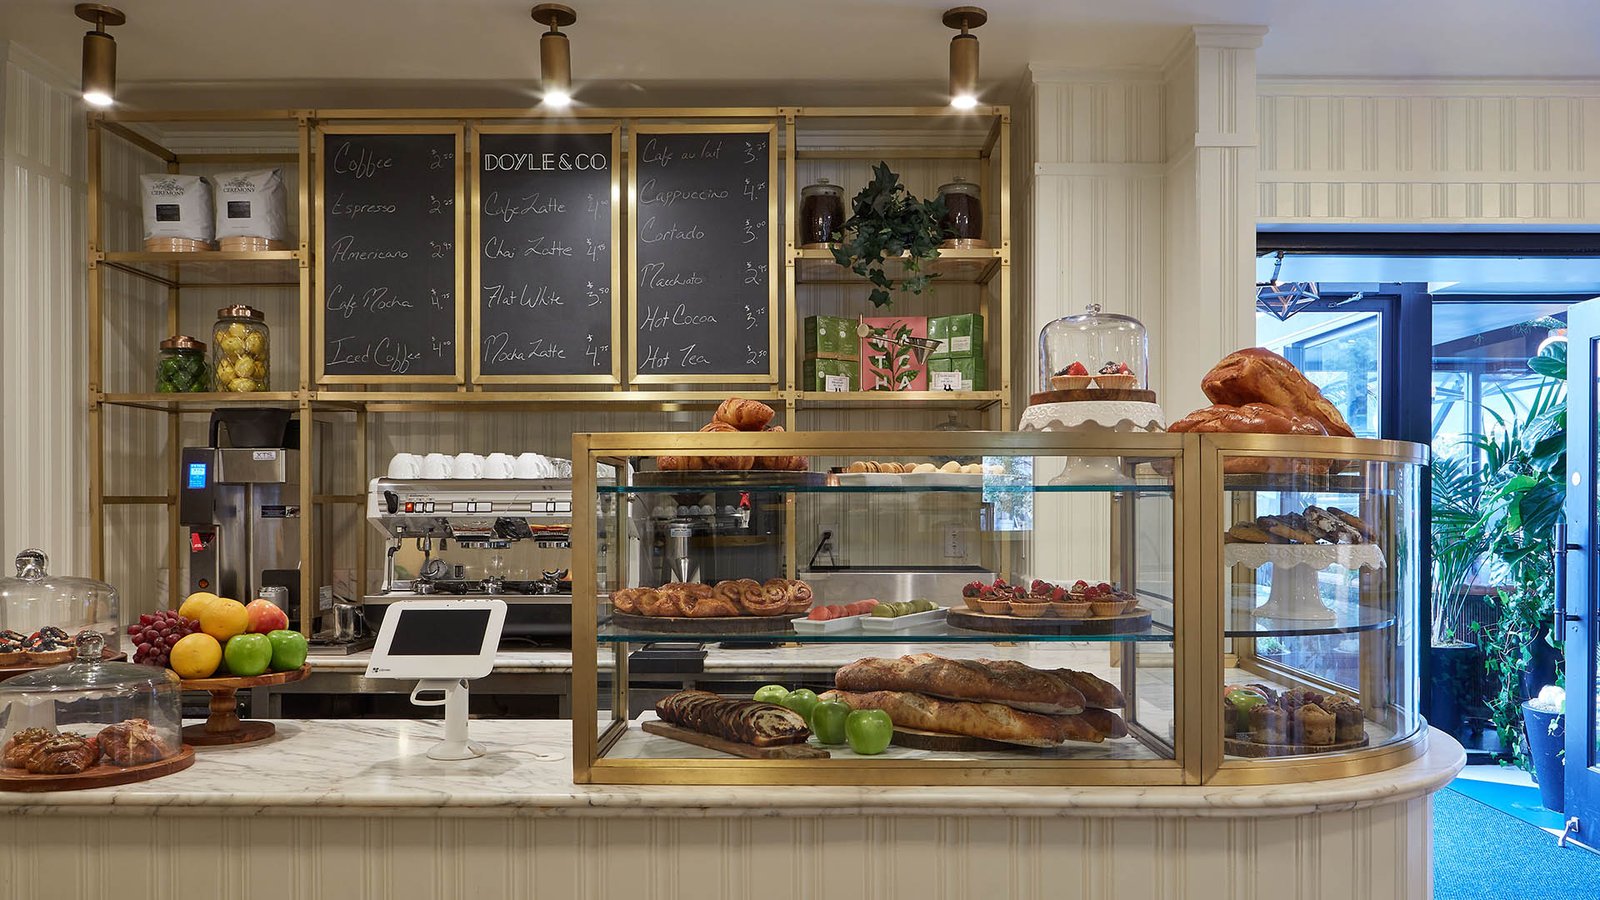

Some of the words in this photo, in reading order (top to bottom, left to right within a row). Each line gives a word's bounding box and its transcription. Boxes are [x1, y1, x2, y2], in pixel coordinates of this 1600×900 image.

[334, 141, 392, 179] Coffee
[642, 138, 672, 167] Cafe
[701, 140, 723, 160] lait
[332, 193, 396, 219] Espresso
[640, 179, 729, 207] Cappuccino
[484, 192, 519, 223] Cafe
[520, 193, 566, 215] Latte
[641, 216, 705, 243] Cortado
[332, 235, 409, 262] Americano
[484, 236, 516, 259] Chai
[524, 237, 573, 257] Latte
[641, 263, 703, 288] Macchiato
[326, 285, 357, 318] Cafe
[363, 287, 413, 312] Mocha
[484, 285, 517, 308] Flat
[520, 284, 564, 308] White
[640, 306, 669, 331] Hot
[672, 304, 718, 326] Cocoa
[326, 336, 370, 366] Iced
[374, 337, 421, 374] Coffee
[484, 332, 526, 362] Mocha
[527, 339, 566, 359] Latte
[640, 345, 670, 368] Hot
[680, 344, 711, 367] Tea
